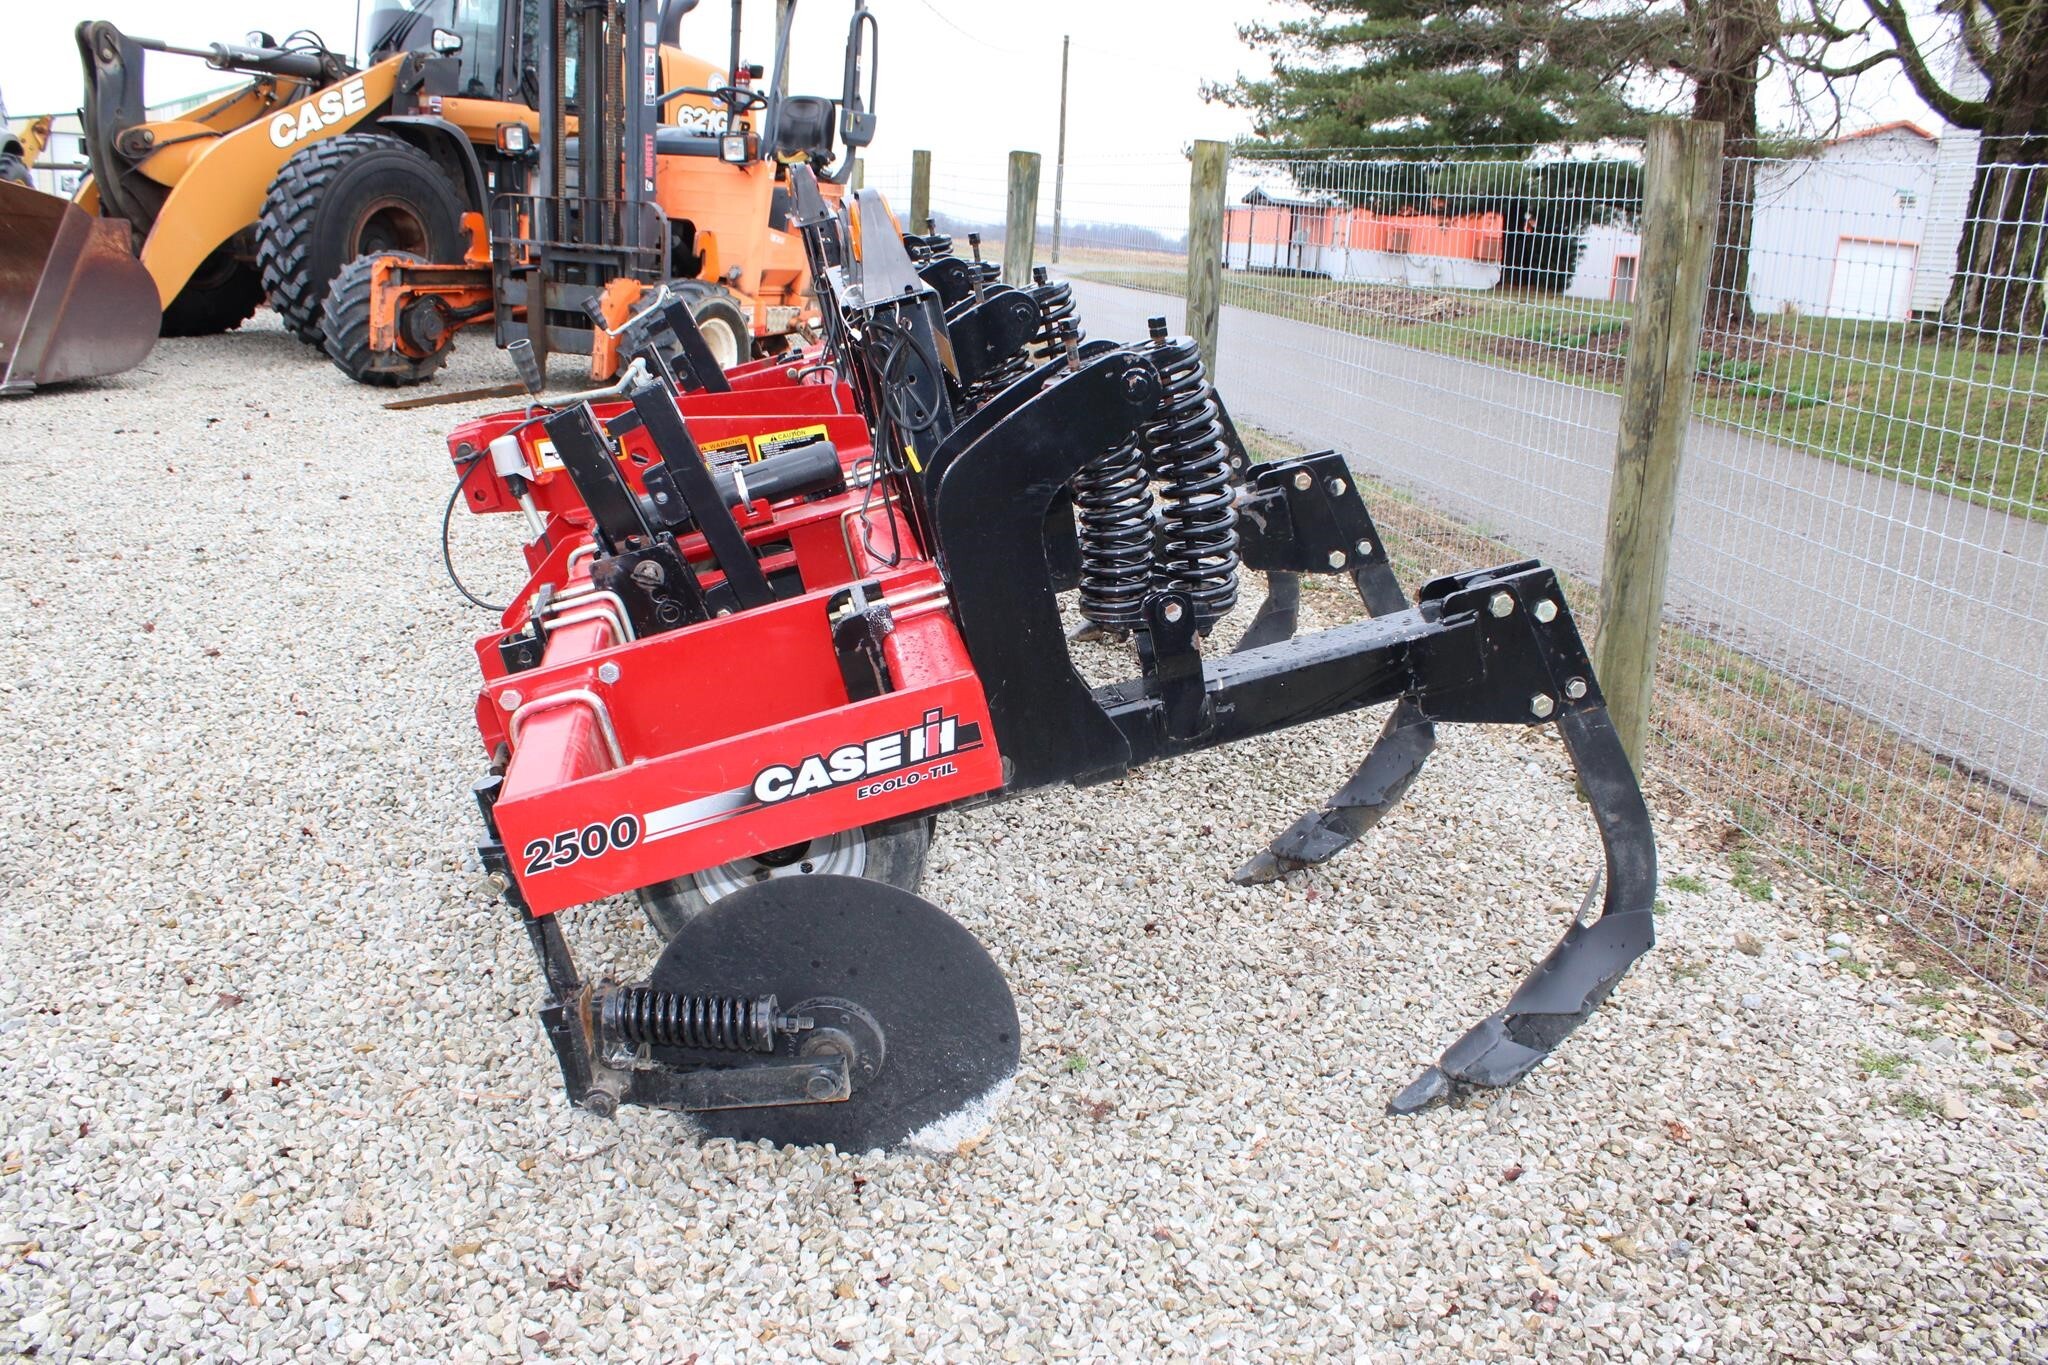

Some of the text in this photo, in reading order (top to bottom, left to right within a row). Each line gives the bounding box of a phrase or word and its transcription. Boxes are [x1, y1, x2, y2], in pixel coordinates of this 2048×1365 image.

[269, 77, 368, 149] CASE
[644, 133, 654, 178] MOFFETT
[710, 438, 744, 450] WARNING
[777, 430, 807, 440] CAUTION
[753, 732, 902, 803] CASE
[523, 813, 641, 877] 2500
